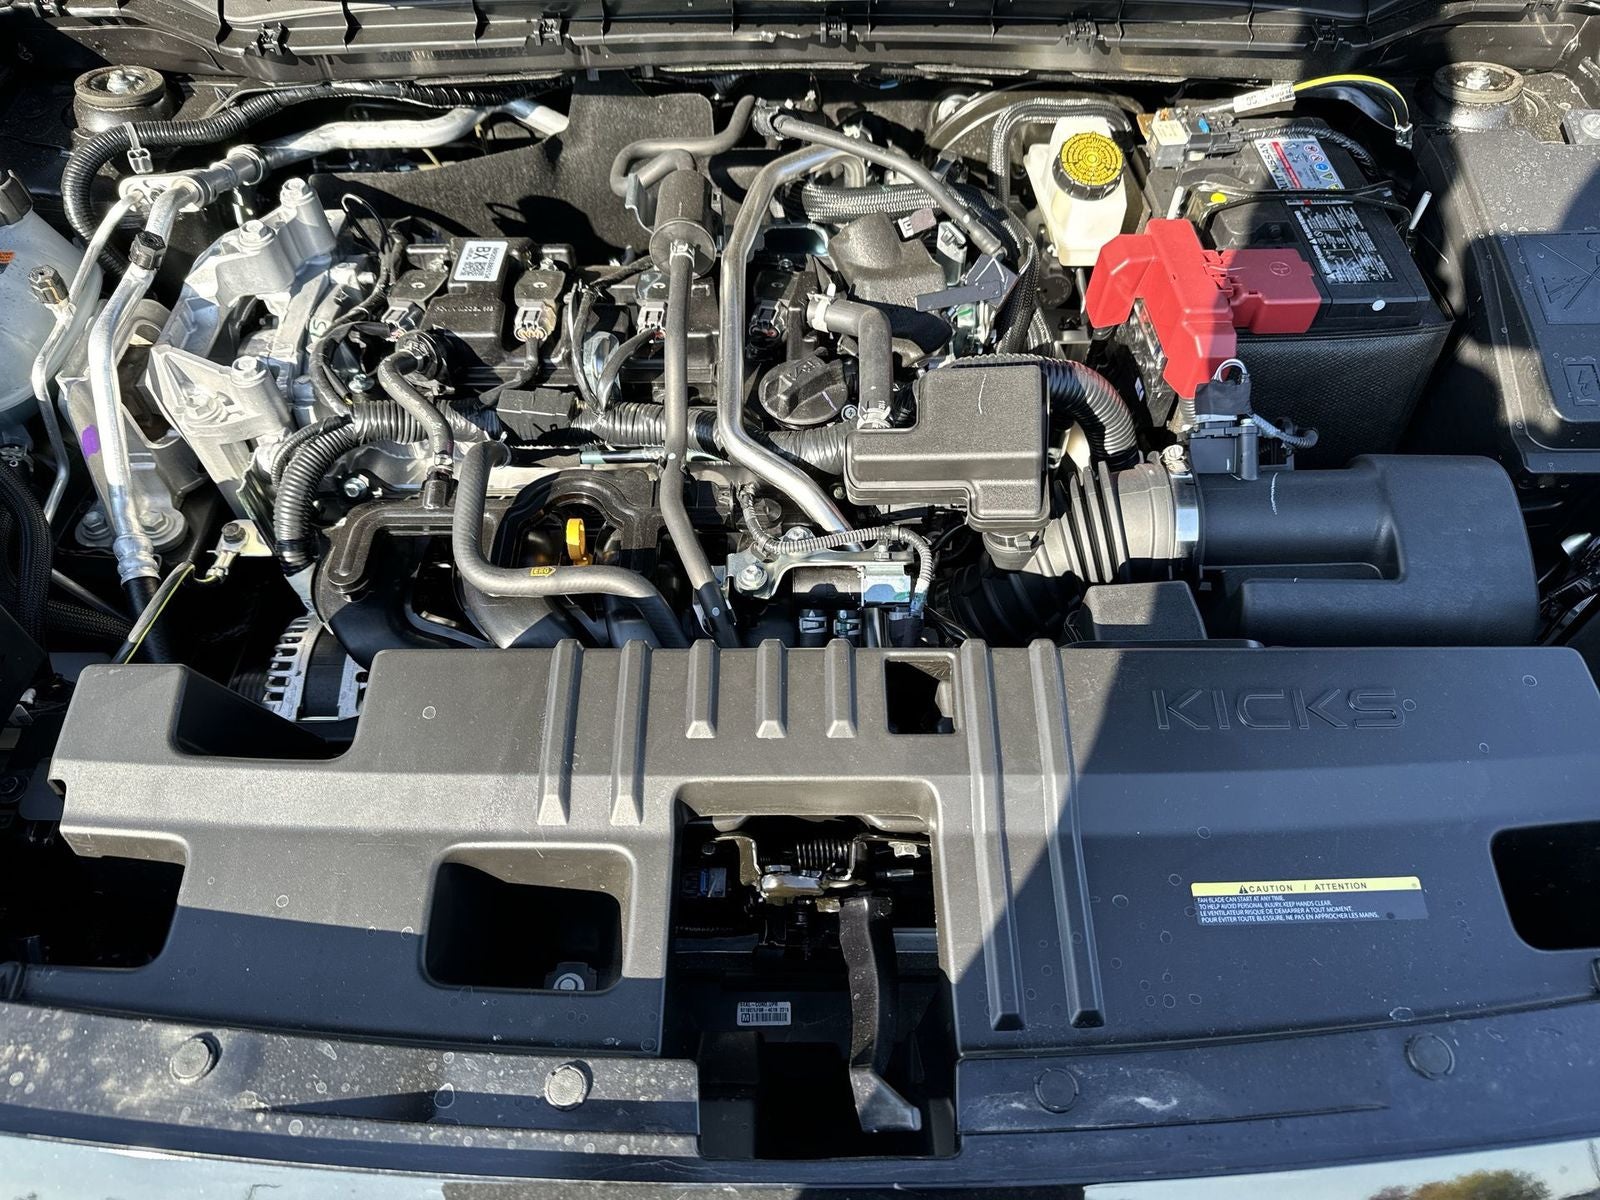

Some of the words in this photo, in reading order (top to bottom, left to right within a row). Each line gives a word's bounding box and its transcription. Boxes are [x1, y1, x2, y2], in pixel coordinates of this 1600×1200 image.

[473, 246, 492, 260] BX
[1152, 688, 1406, 730] KICKS
[1248, 884, 1294, 893] CAUTION
[1314, 882, 1368, 891] ATTENTION
[1197, 896, 1208, 904] FAN
[1207, 909, 1244, 917] VENTILATEUR
[1244, 908, 1265, 916] RISQUE
[1237, 915, 1256, 923] TOUTE
[1314, 912, 1348, 920] APPROCHER
[1359, 911, 1380, 919] MAINS.
